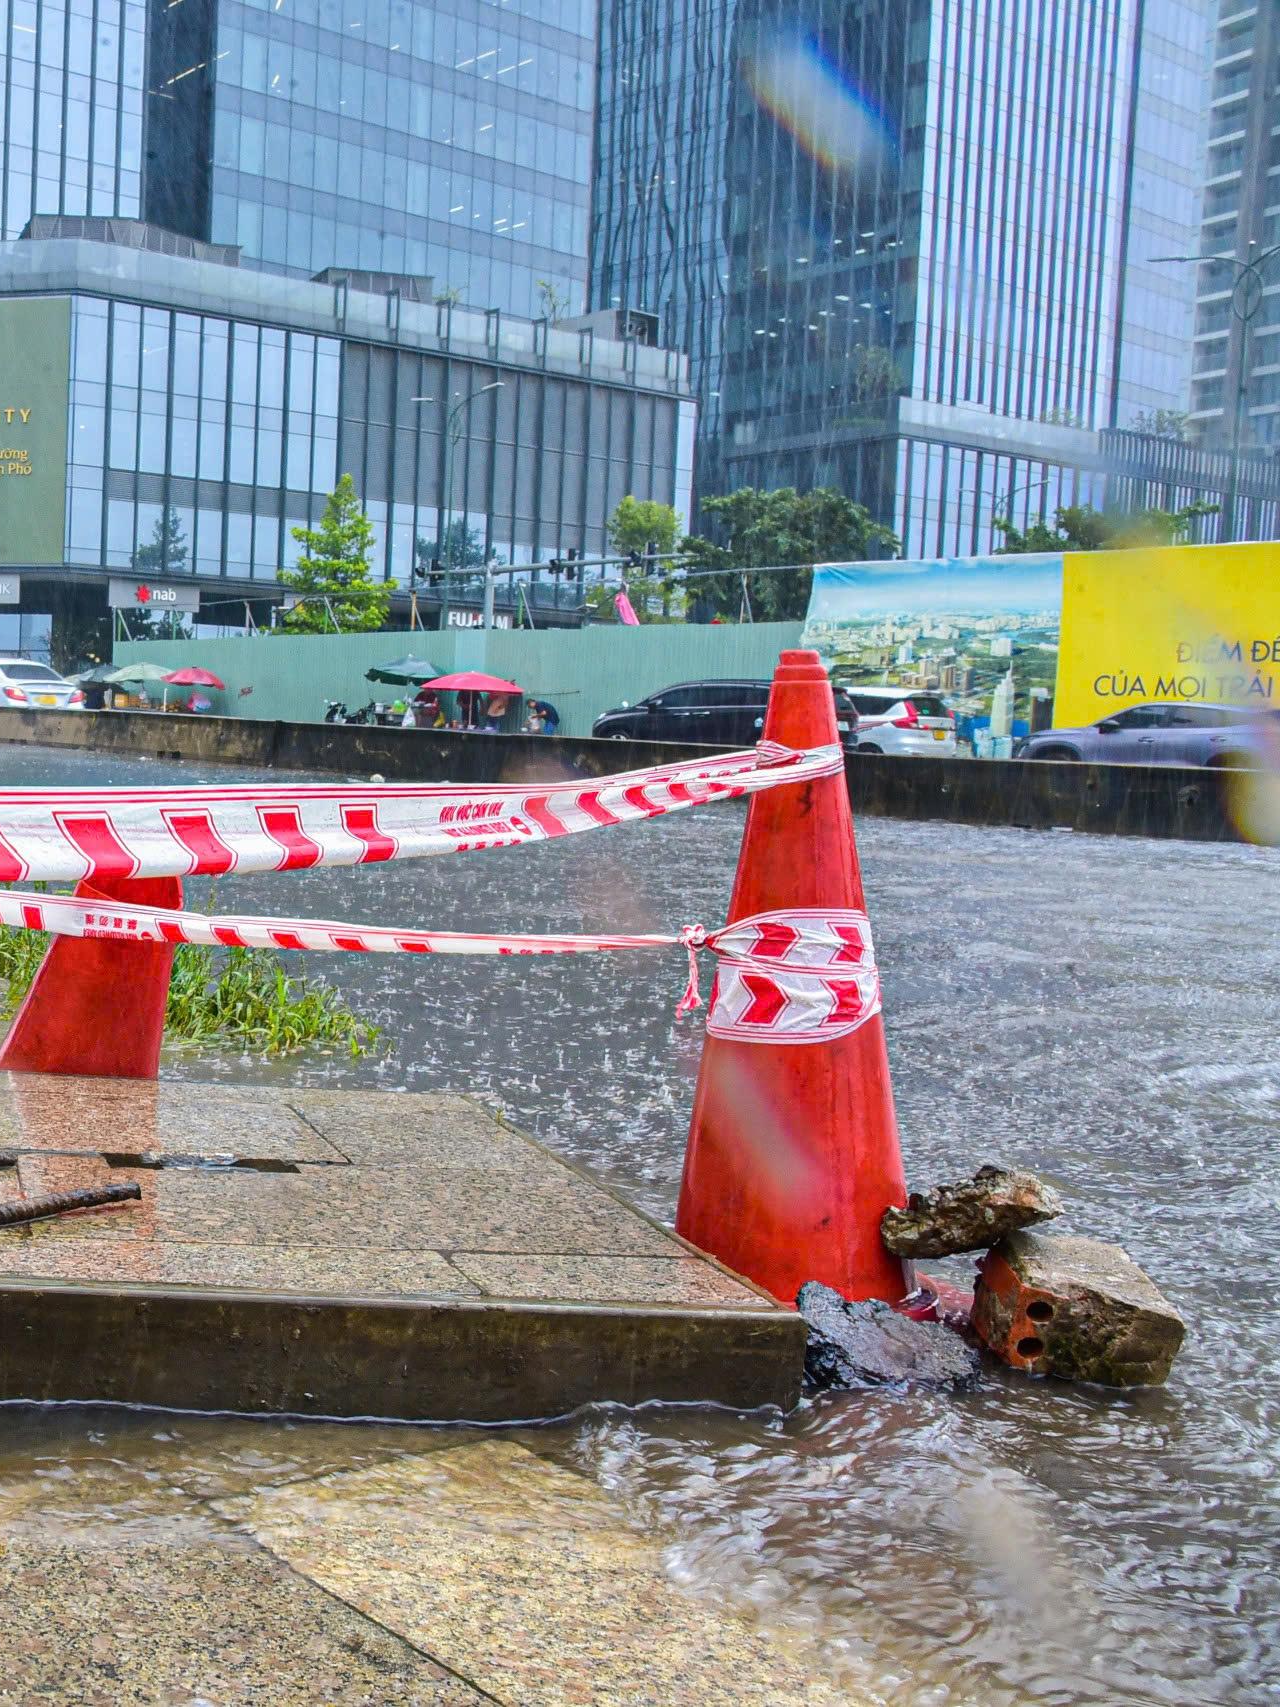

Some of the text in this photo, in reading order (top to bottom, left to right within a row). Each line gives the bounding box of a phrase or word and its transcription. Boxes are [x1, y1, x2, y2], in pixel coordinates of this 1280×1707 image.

[8, 461, 33, 476] Phố
[152, 587, 177, 602] nab
[1175, 632, 1242, 664] ĐIỂM
[1093, 668, 1274, 702] CỦA MỌI TRẢI
